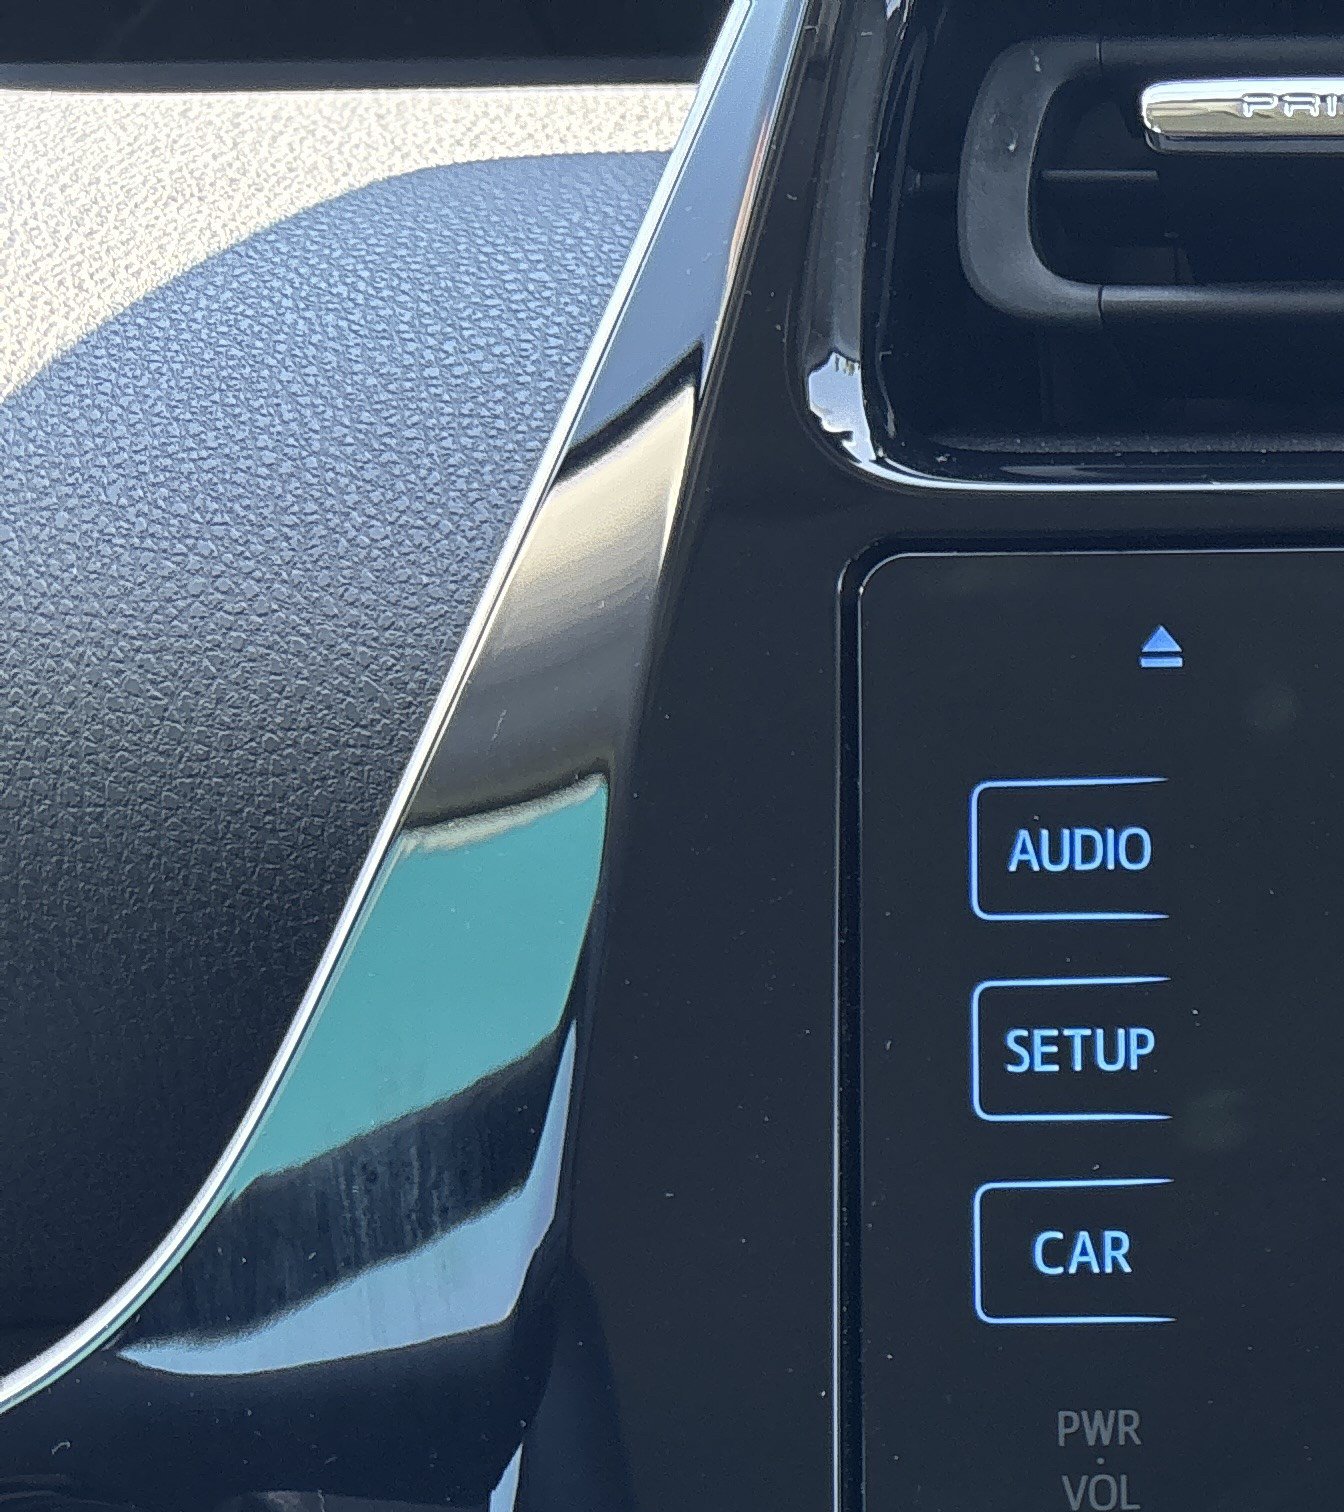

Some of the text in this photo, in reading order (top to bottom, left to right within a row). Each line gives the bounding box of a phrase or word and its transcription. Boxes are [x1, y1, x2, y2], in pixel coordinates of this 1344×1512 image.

[1007, 827, 1153, 872] AUDIO
[1004, 1027, 1156, 1073] SETUP
[1033, 1230, 1133, 1275] CAR
[1057, 1408, 1142, 1447] PWR
[1061, 1473, 1141, 1511] VOL
